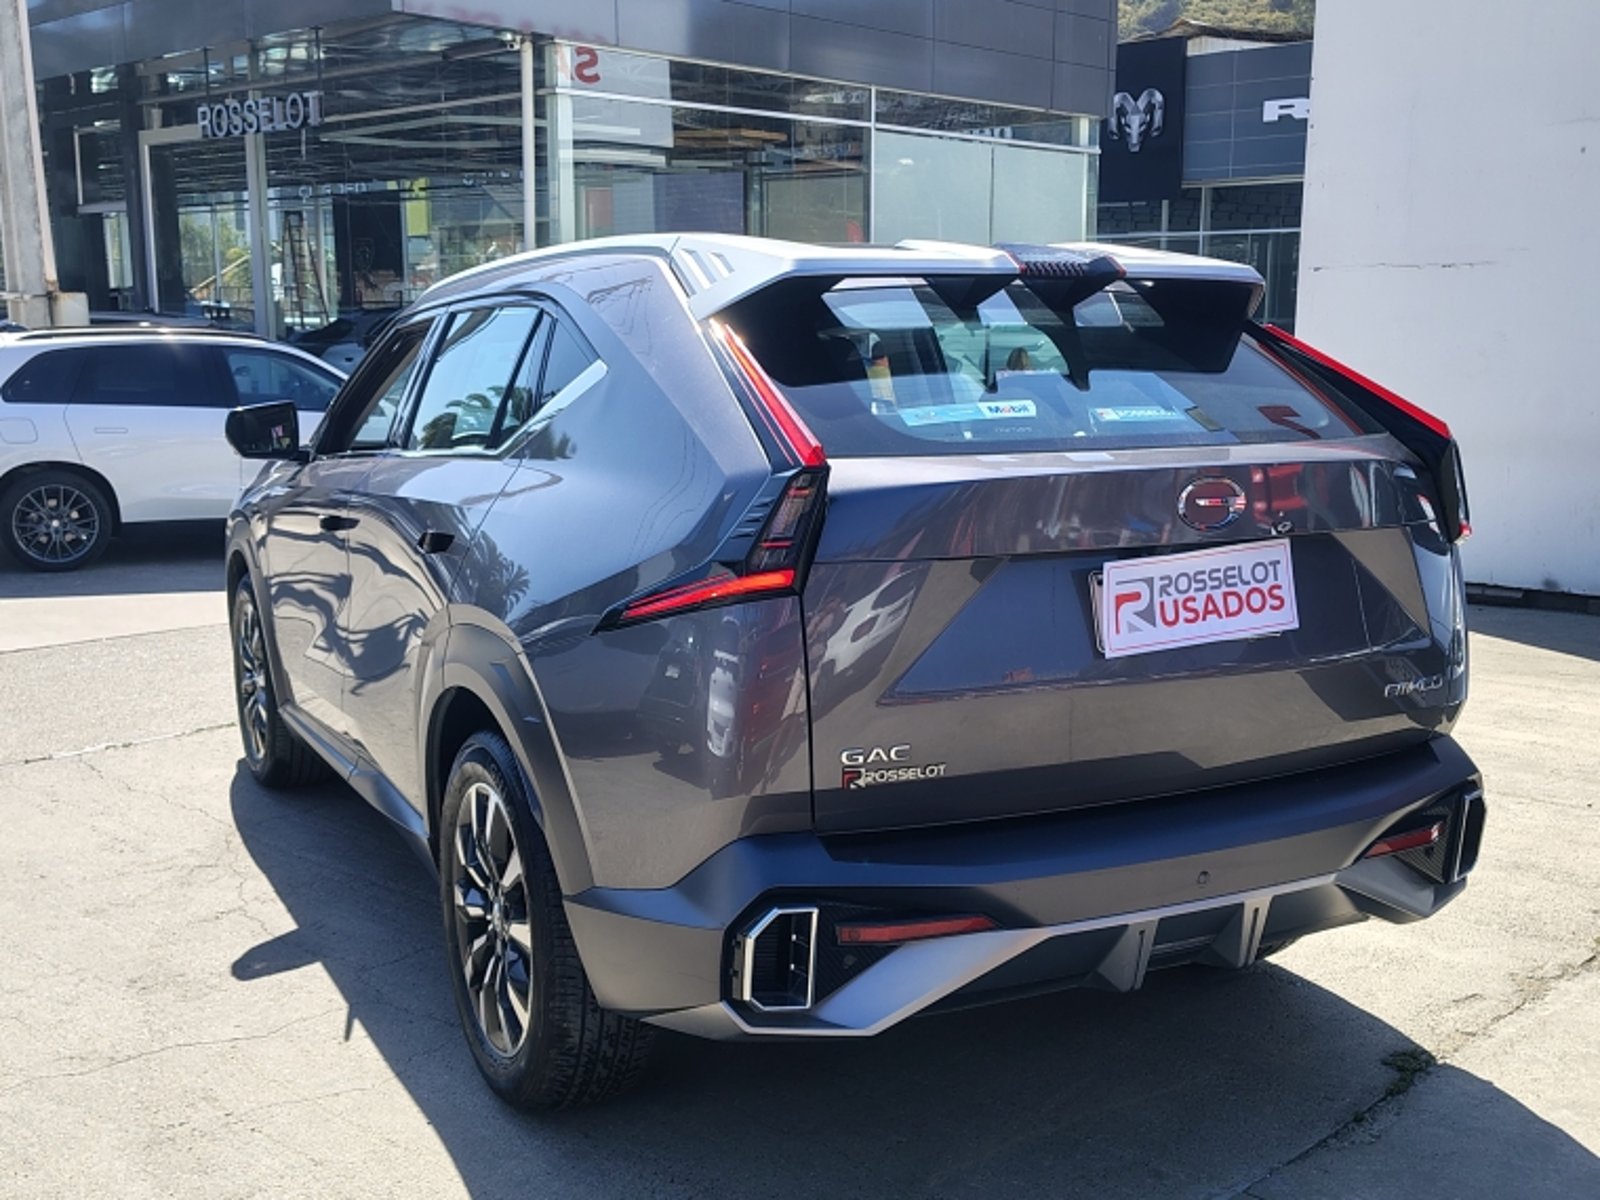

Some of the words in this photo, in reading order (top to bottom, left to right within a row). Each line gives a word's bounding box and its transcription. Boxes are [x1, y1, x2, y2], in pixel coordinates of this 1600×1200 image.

[197, 91, 323, 138] ROSSELOT
[1159, 560, 1281, 597] ROSSELOT
[1159, 584, 1285, 628] USADOS
[841, 744, 911, 766] GAC
[865, 763, 947, 784] ROSSELOT
